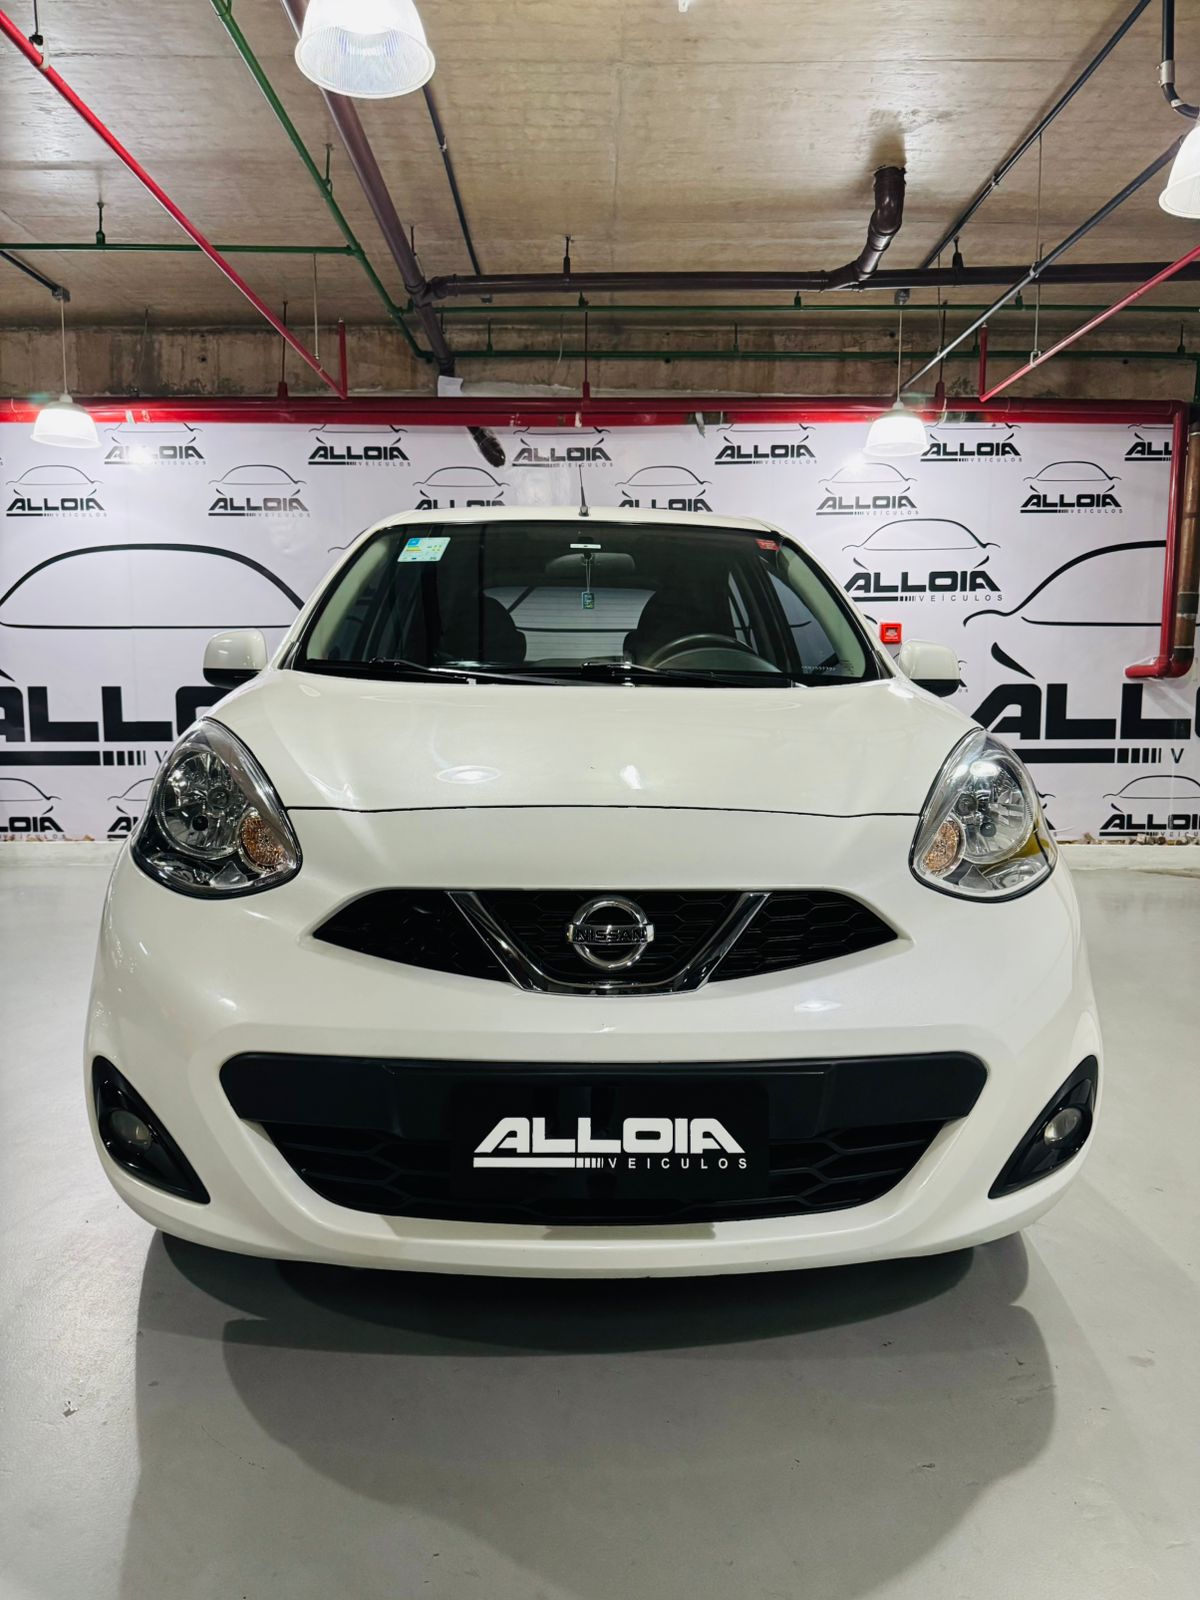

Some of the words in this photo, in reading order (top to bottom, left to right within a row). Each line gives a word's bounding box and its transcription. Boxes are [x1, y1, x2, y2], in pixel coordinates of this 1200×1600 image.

[105, 446, 205, 460] AOIA
[308, 446, 409, 461] ALLOIA
[513, 447, 612, 462] ALLOIA
[714, 445, 816, 459] ALLOIA
[921, 443, 1021, 456] ALLOIA
[6, 498, 105, 511] ALLOIA
[208, 498, 309, 511] ALLOIA
[816, 496, 917, 510] ALLOIA
[1020, 494, 1123, 508] ALLOIA
[844, 571, 1001, 593] ALLOIA
[970, 683, 1200, 740] ALL
[0, 816, 64, 832] OIA
[575, 929, 647, 943] NISSAN
[473, 1117, 746, 1154] ALLOIA
[608, 1157, 747, 1169] VEICULOS
